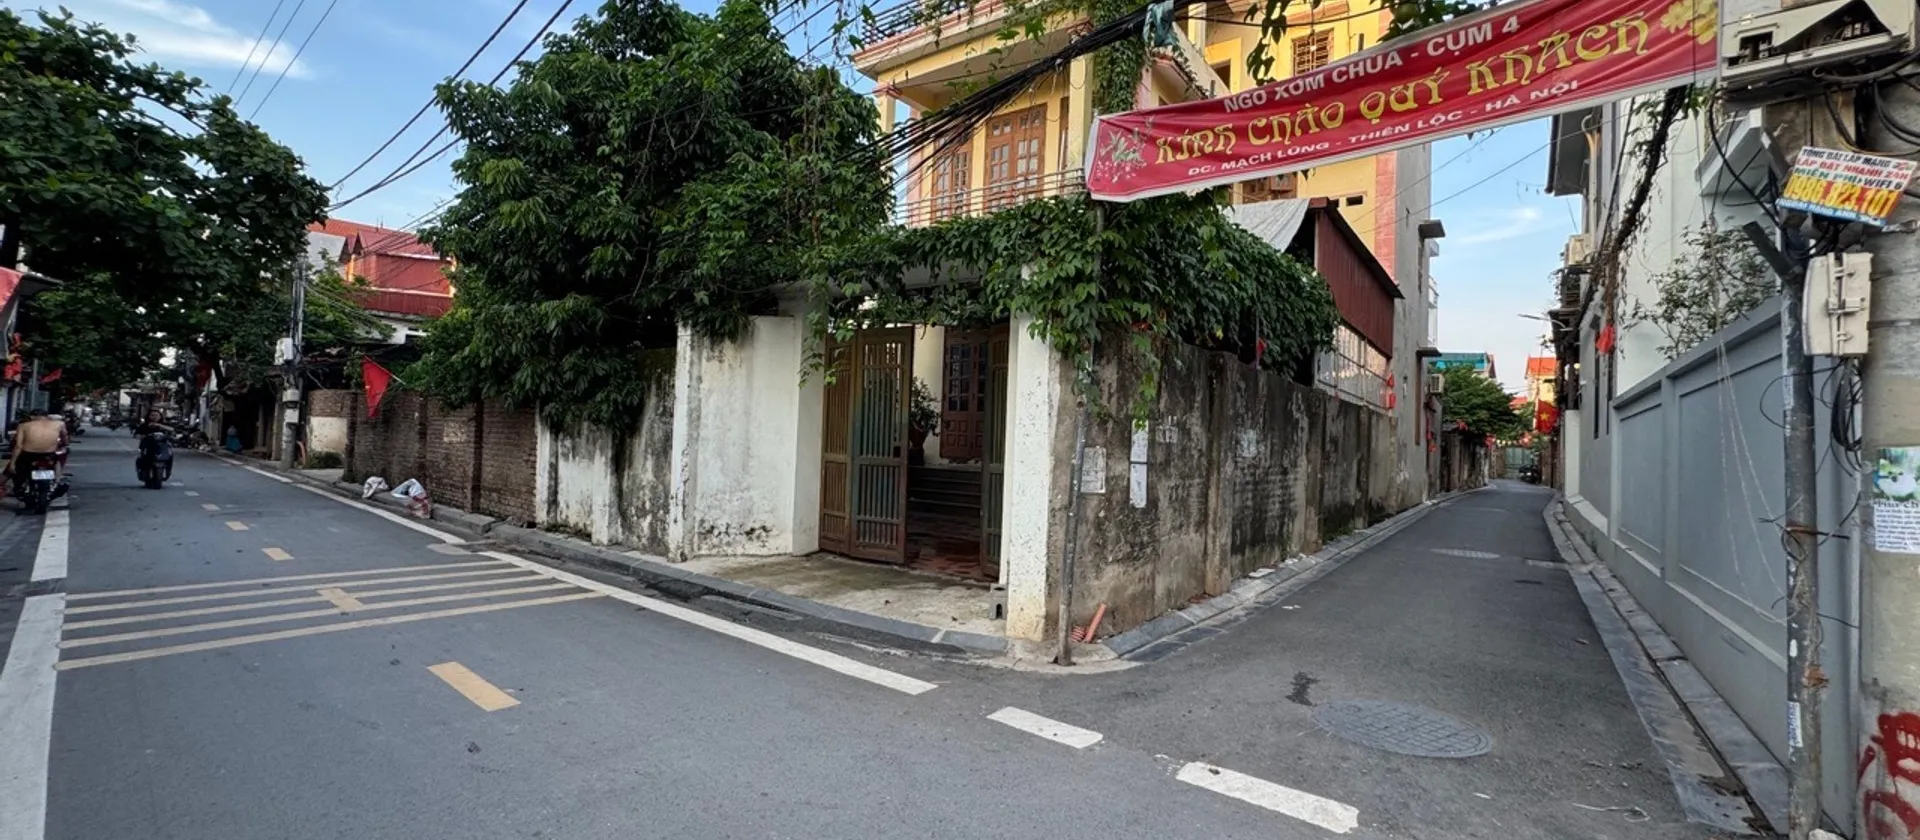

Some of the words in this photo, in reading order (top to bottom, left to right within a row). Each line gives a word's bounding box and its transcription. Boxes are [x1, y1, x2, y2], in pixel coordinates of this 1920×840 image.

[1427, 22, 1492, 57] CỤM
[1502, 15, 1520, 33] 4
[1155, 123, 1237, 164] KÍNH
[1247, 101, 1345, 148] CHÀO
[1359, 66, 1450, 125] QUÝ
[1466, 10, 1649, 96] KHÁCH
[1417, 110, 1463, 129] LỘC
[1485, 94, 1521, 112] HÀ
[1530, 79, 1578, 99] NỘI
